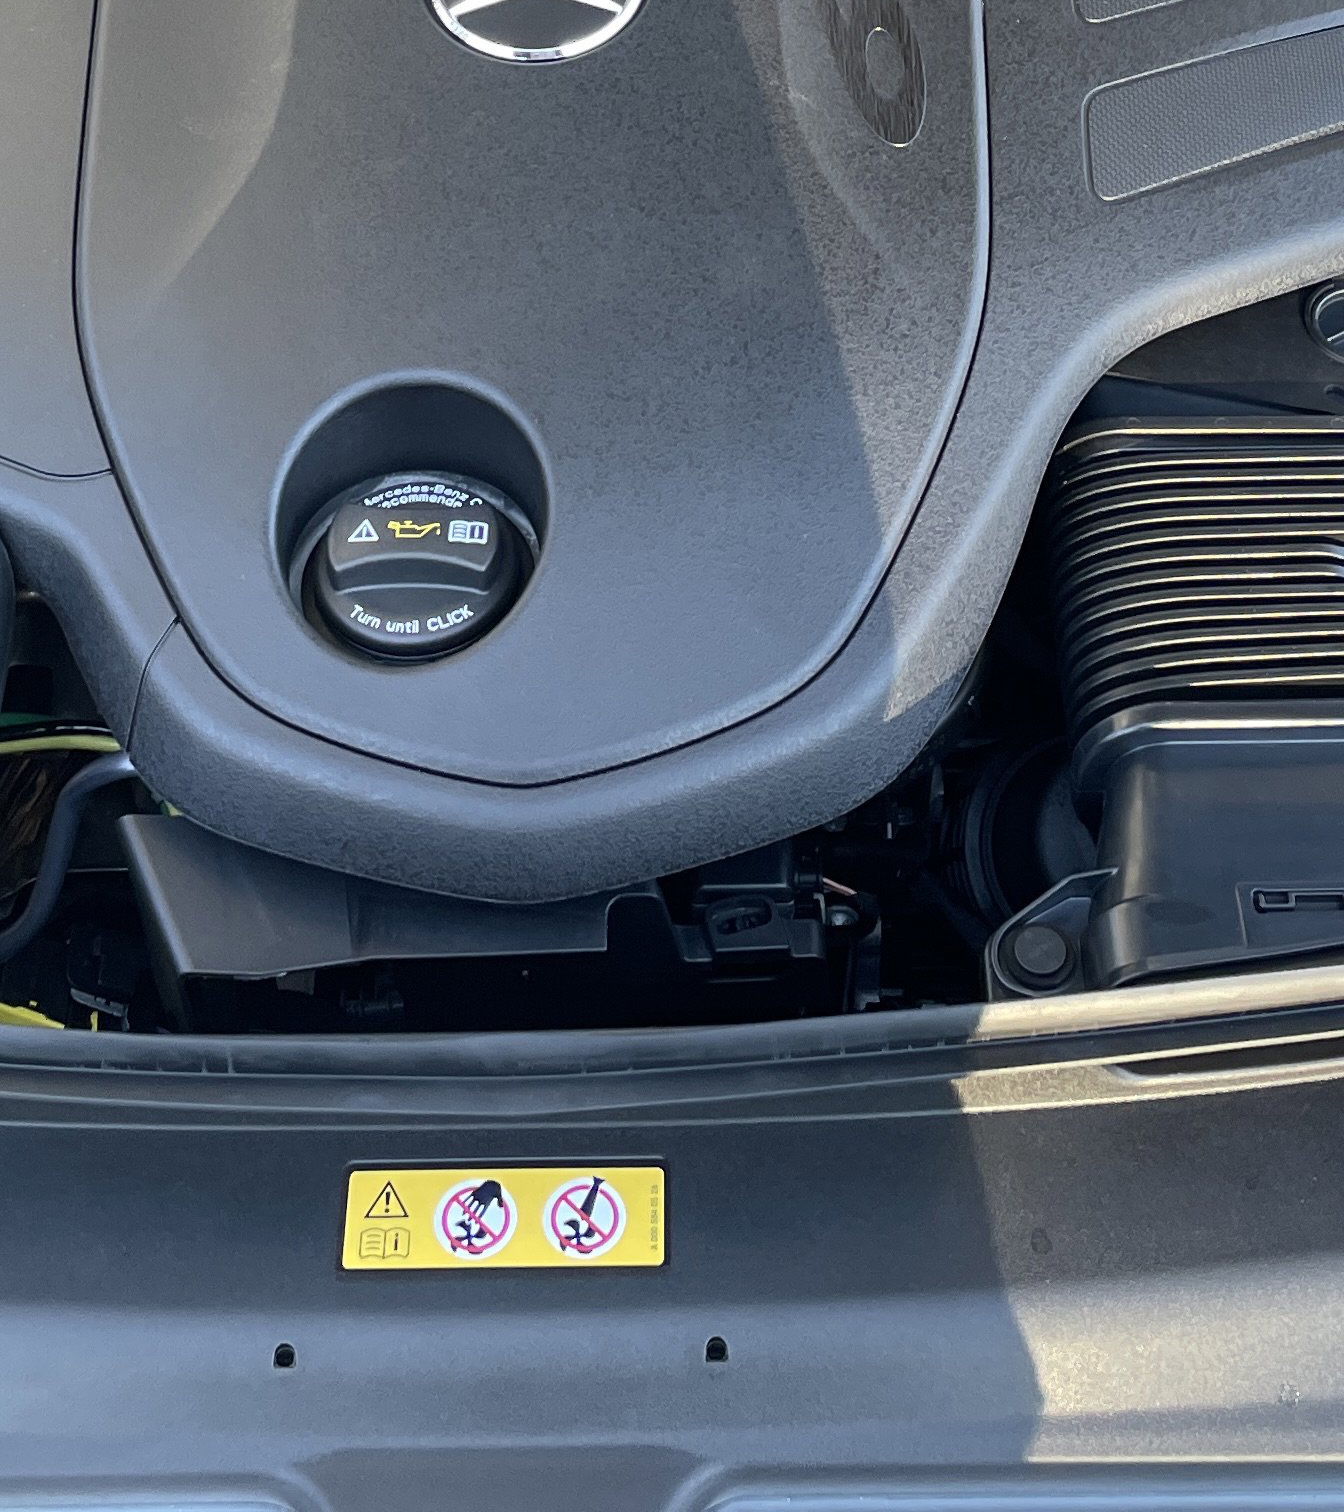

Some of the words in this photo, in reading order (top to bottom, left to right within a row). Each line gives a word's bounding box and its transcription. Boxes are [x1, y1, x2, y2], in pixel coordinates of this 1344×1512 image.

[349, 604, 381, 630] Turn
[385, 619, 420, 634] until
[426, 603, 475, 632] CLICK
